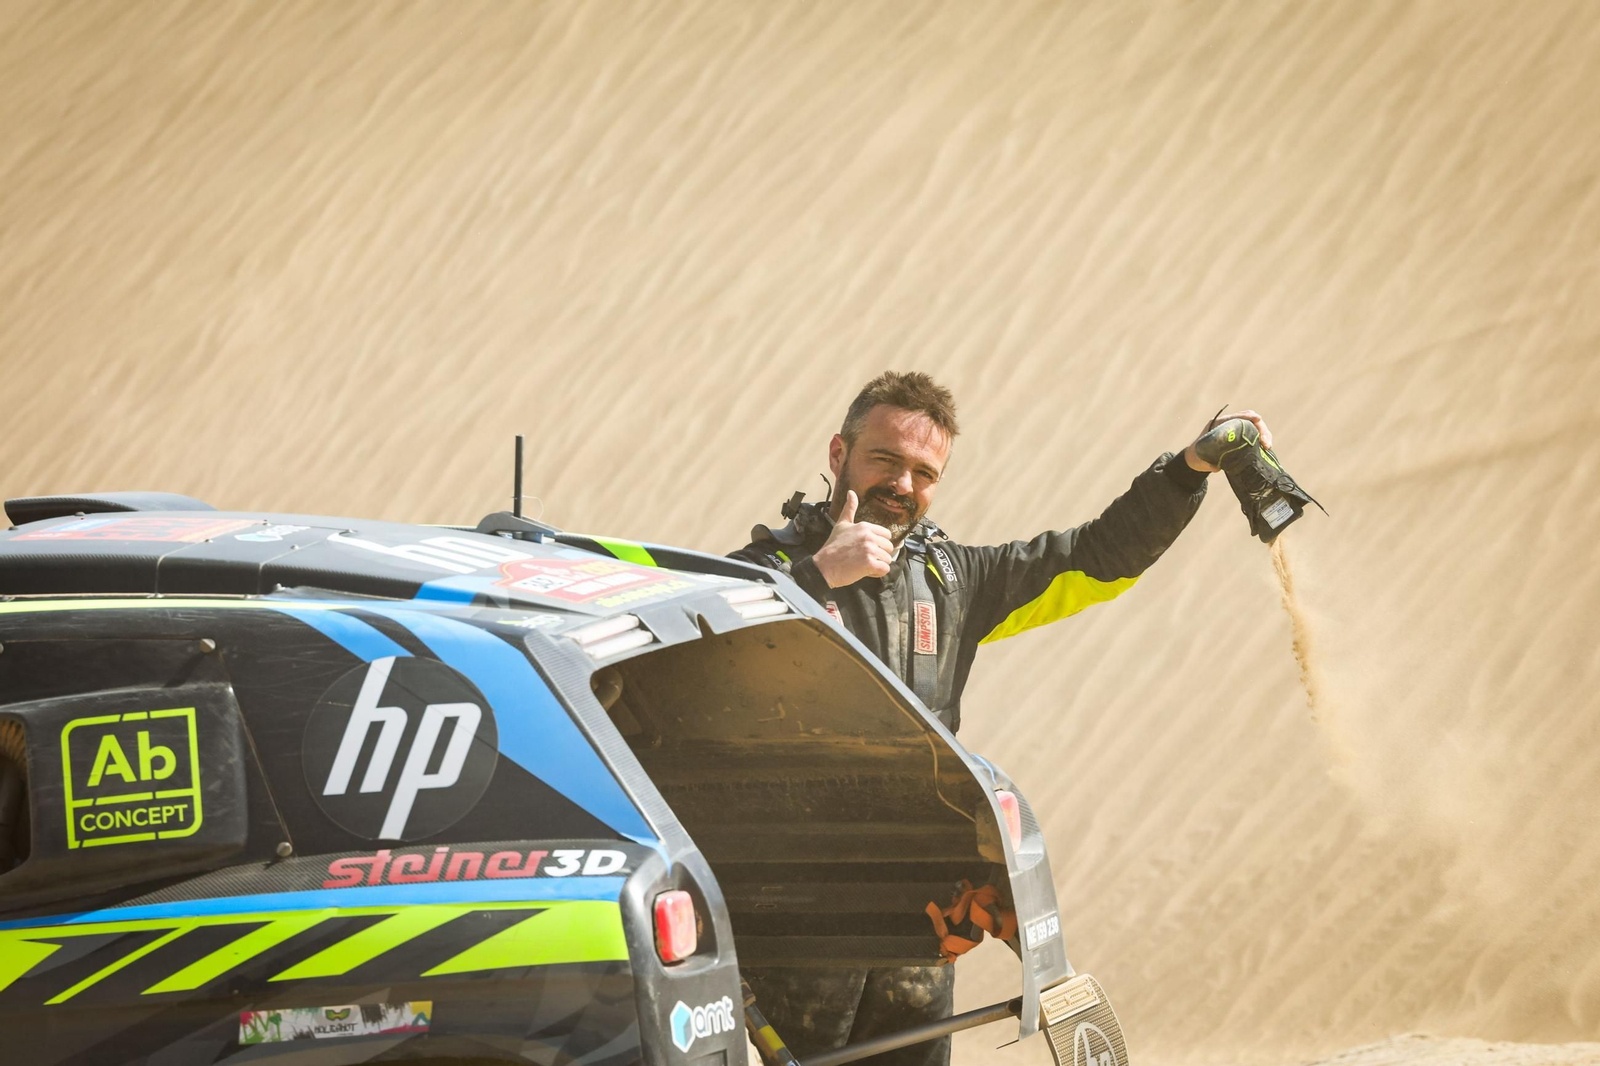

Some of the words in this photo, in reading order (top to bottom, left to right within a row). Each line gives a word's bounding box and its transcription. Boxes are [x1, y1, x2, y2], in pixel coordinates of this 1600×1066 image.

[920, 606, 931, 649] SIMPSON
[87, 731, 177, 787] Ab
[322, 656, 482, 839] hp
[80, 804, 188, 832] CONCEPT
[693, 995, 735, 1038] amt
